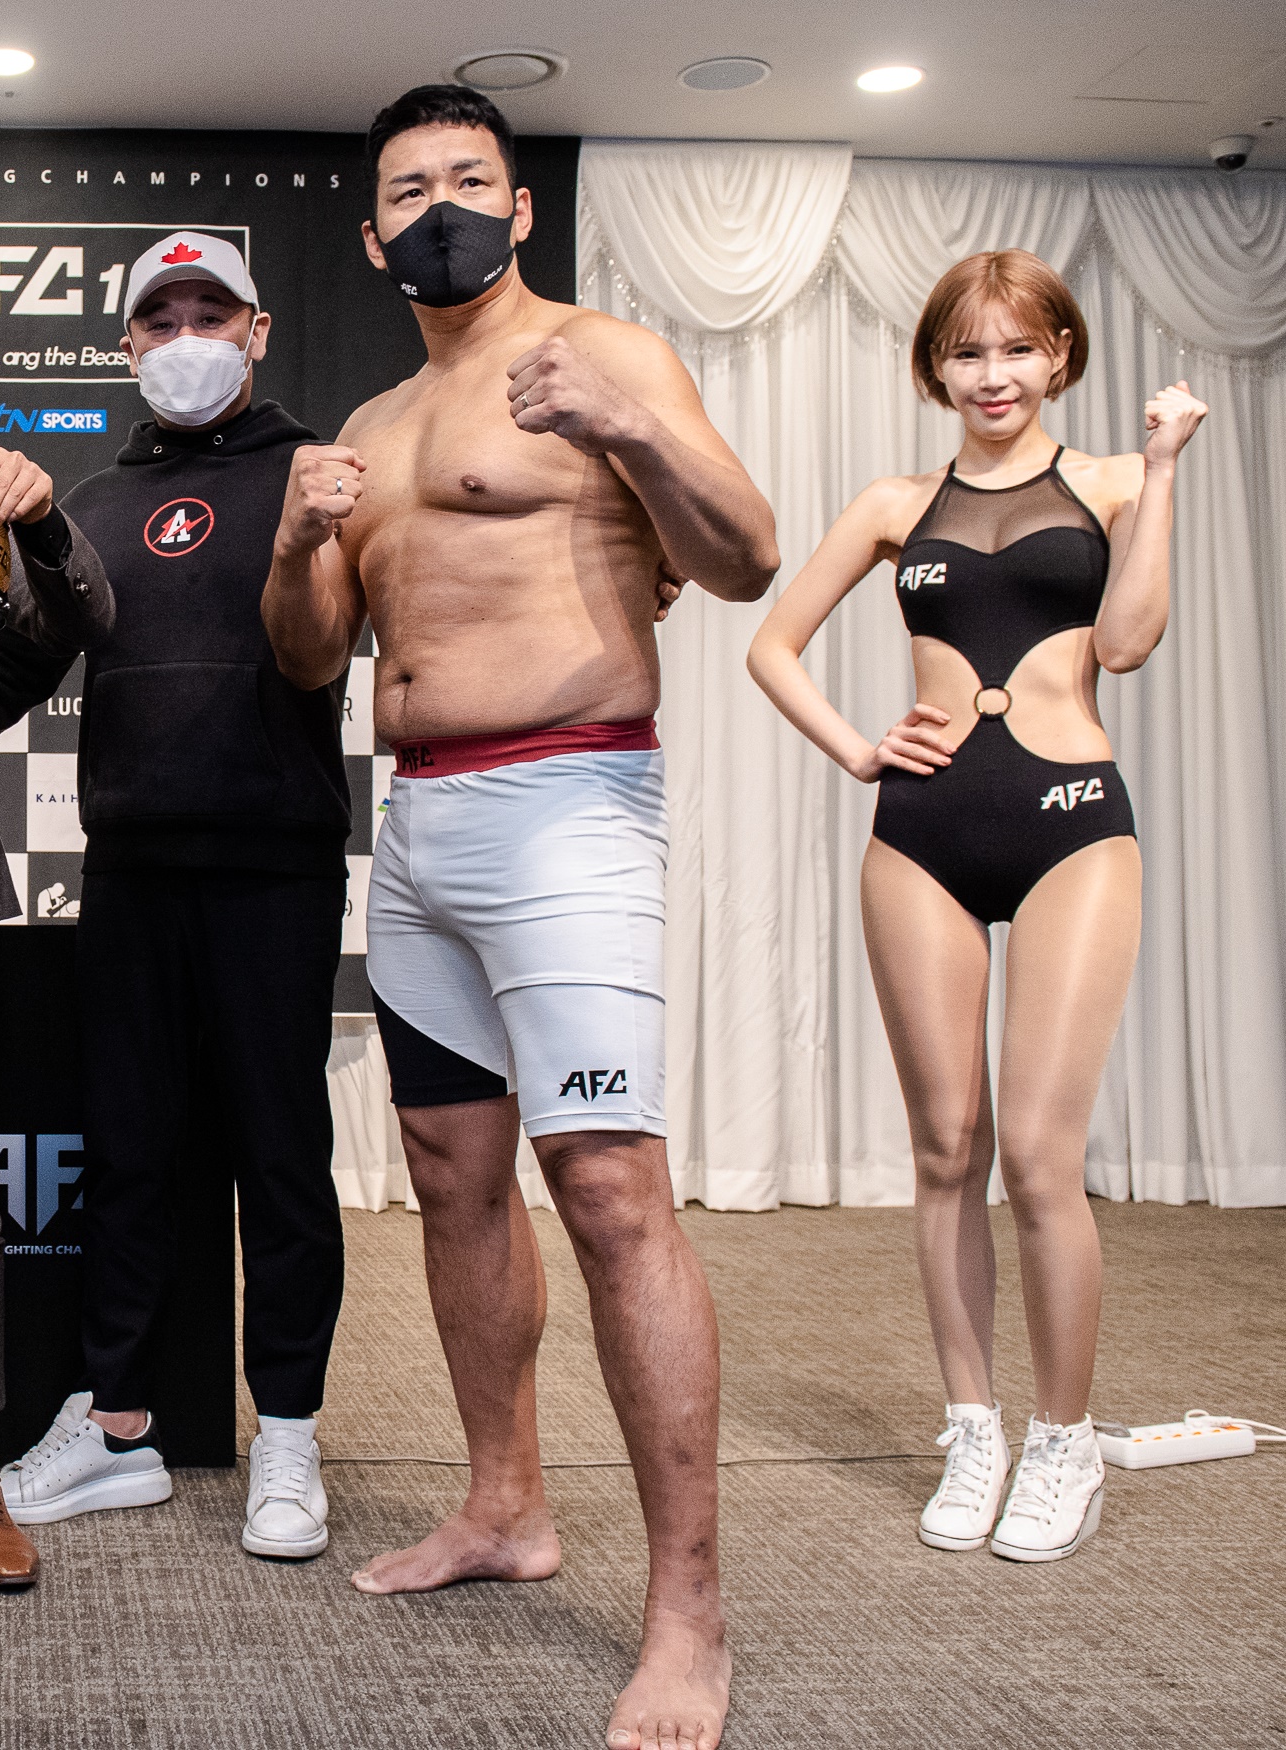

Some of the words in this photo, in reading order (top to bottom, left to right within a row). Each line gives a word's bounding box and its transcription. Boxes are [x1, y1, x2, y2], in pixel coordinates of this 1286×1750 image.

[3, 351, 40, 370] ang
[45, 346, 76, 366] the
[42, 413, 103, 429] SPORTS
[899, 563, 947, 591] AFC
[400, 745, 434, 774] AFC
[1040, 777, 1105, 811] AFC
[559, 1069, 628, 1103] AFC
